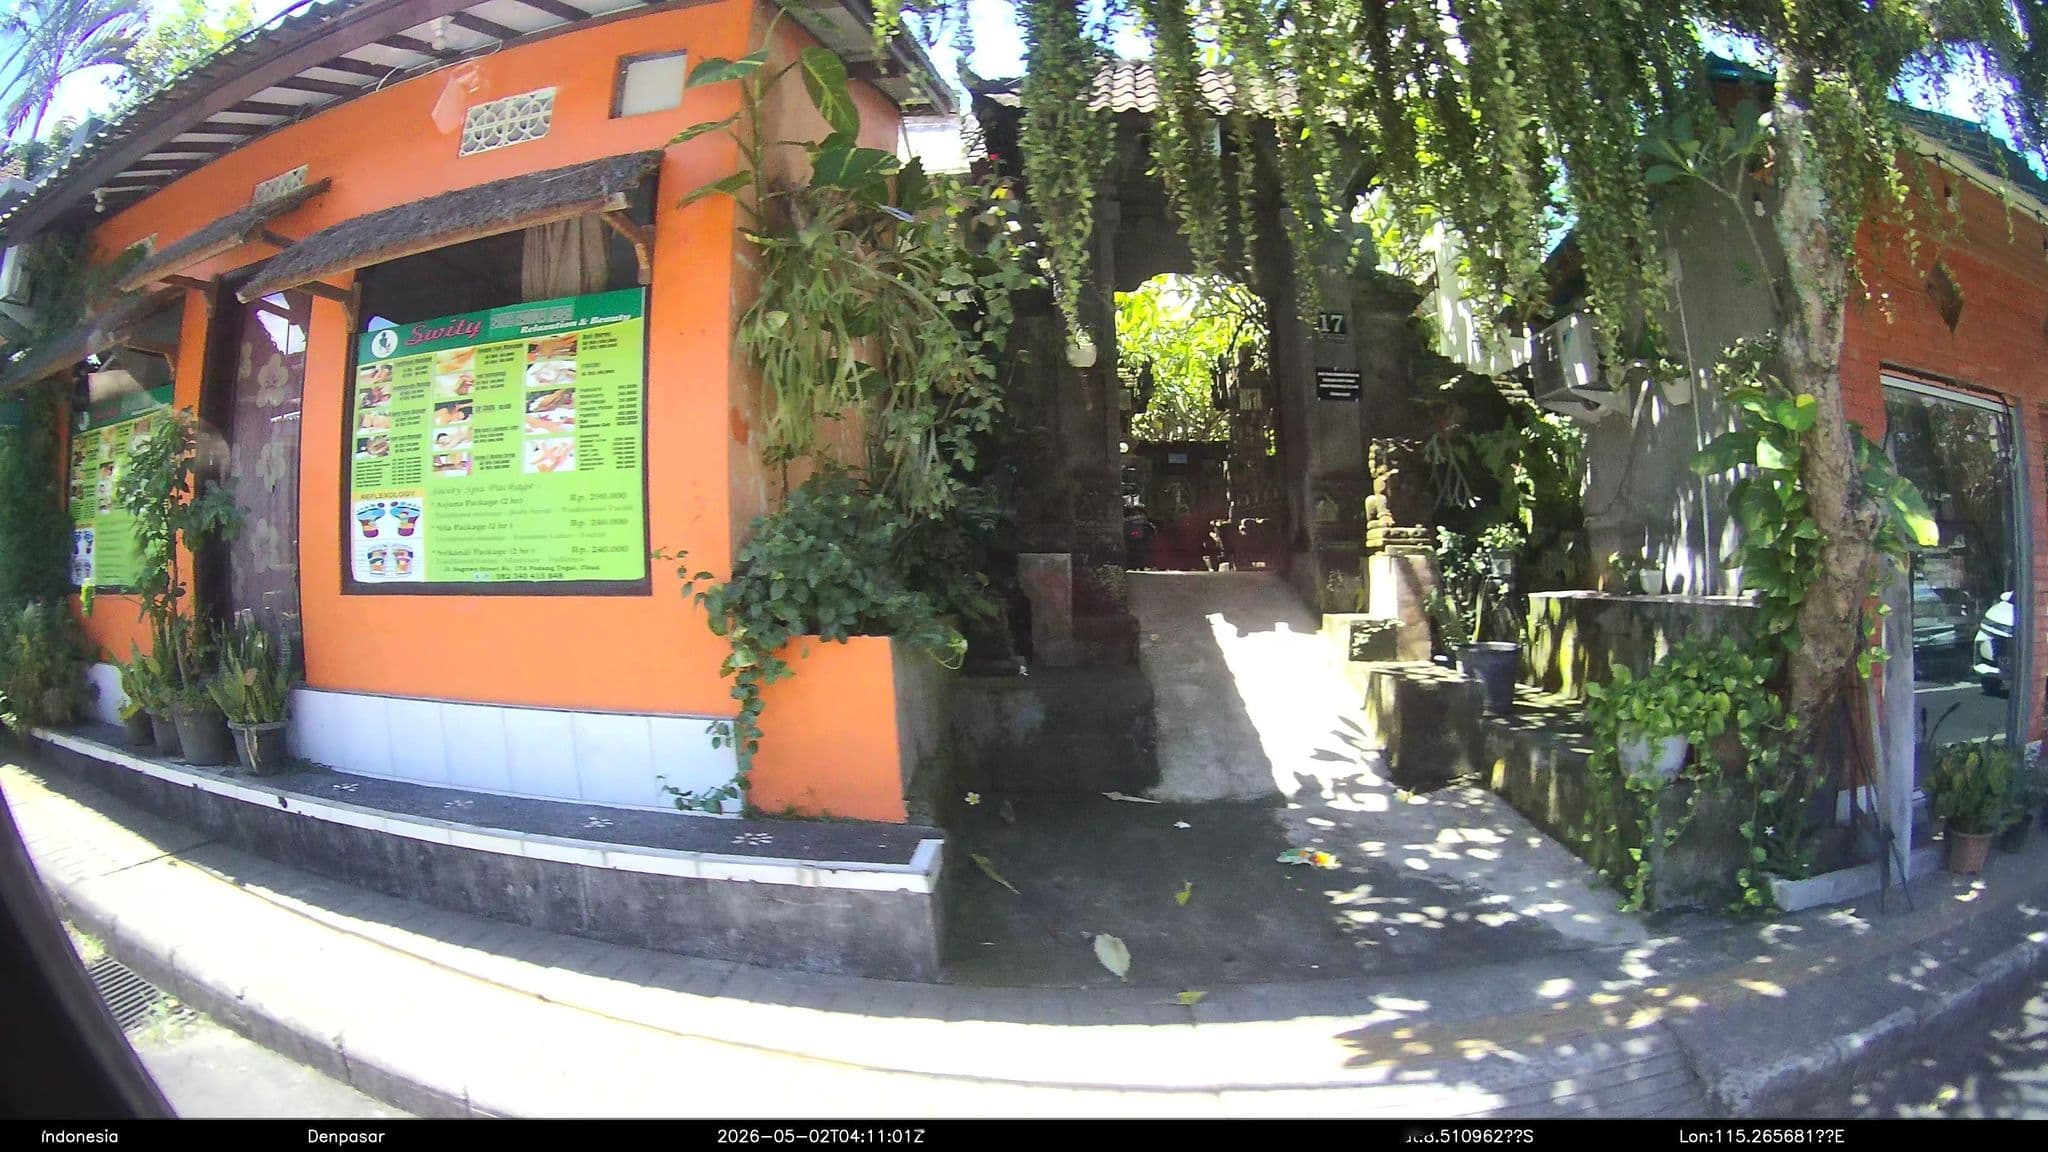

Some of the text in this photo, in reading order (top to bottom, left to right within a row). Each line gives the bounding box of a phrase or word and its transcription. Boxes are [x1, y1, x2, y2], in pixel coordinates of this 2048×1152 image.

[407, 317, 484, 346] Swity
[520, 314, 631, 334] Relaxation & Beauty
[1319, 314, 1344, 333] 17
[361, 491, 415, 500] REFLEXOLOGY
